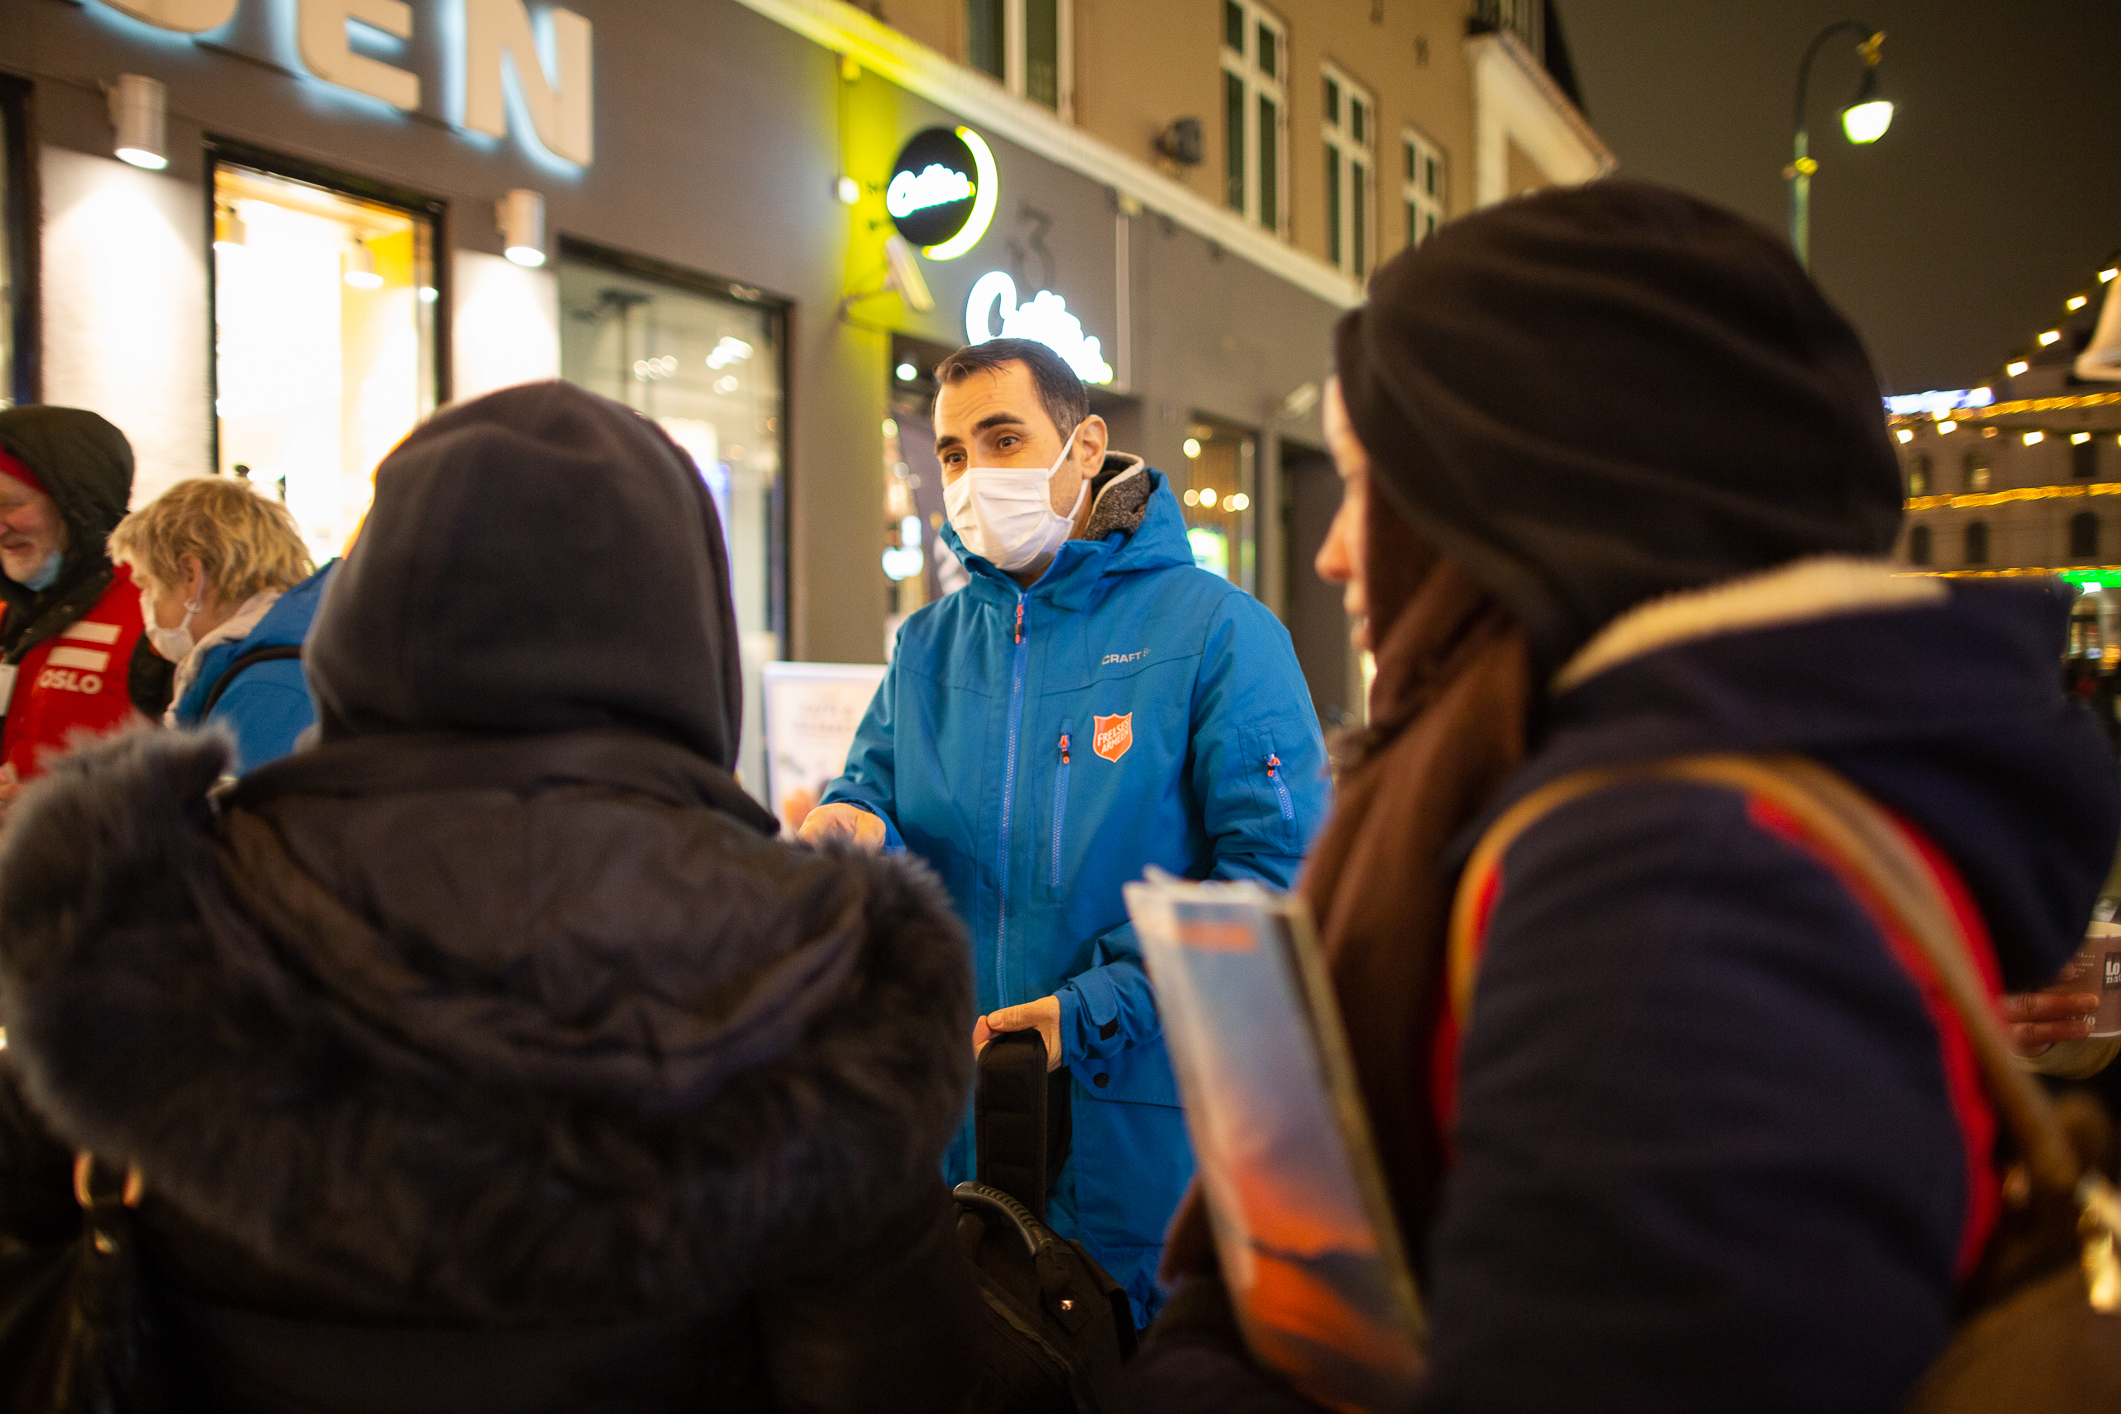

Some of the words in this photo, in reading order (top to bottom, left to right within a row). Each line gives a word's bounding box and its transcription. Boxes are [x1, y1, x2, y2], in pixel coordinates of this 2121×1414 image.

[92, 0, 594, 167] EN
[1101, 651, 1142, 665] CRAFT
[38, 669, 103, 695] OSLO
[1097, 717, 1129, 747] FRELSES
[1101, 728, 1129, 754] ARMEEN
